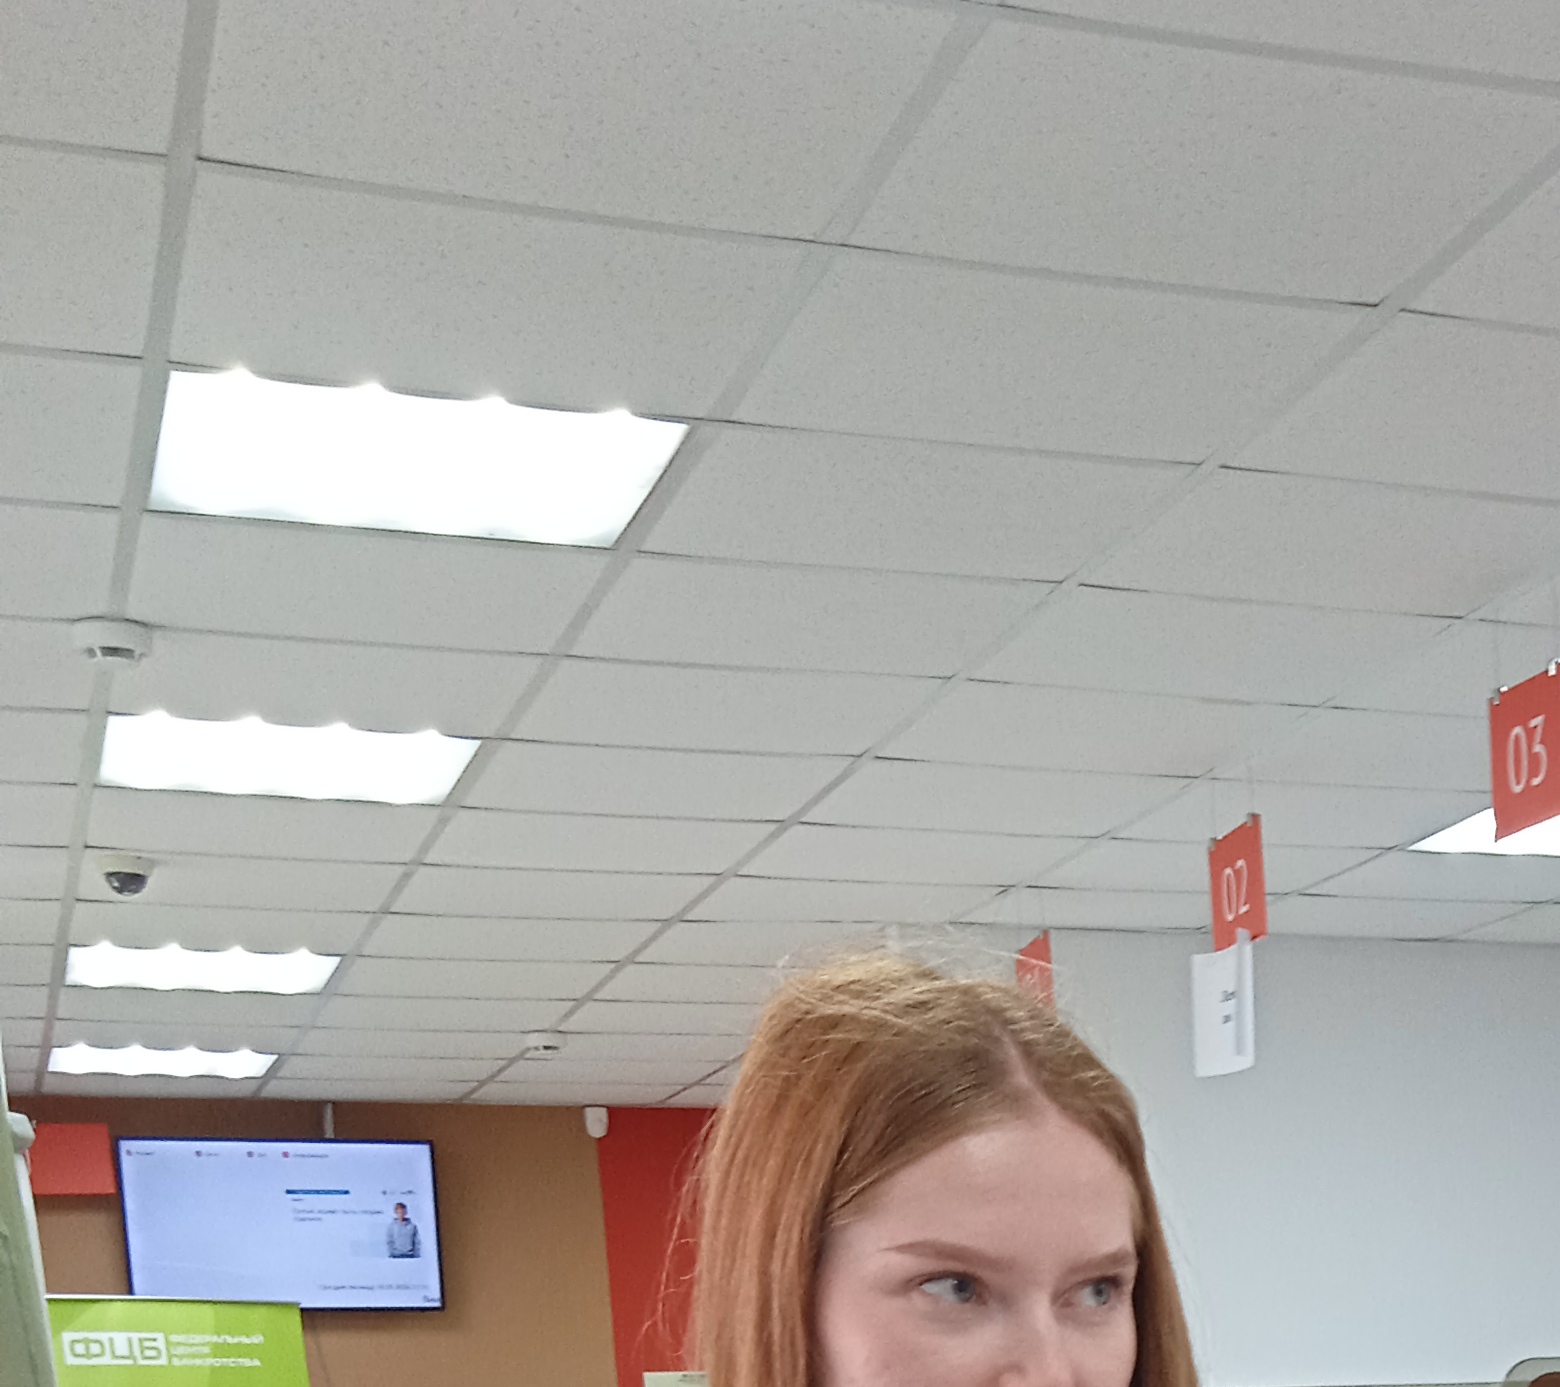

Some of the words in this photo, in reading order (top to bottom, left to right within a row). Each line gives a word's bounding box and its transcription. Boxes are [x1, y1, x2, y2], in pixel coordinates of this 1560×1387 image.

[1506, 714, 1548, 794] 03
[1220, 858, 1250, 922] 02
[69, 1337, 162, 1362] ФЦБ
